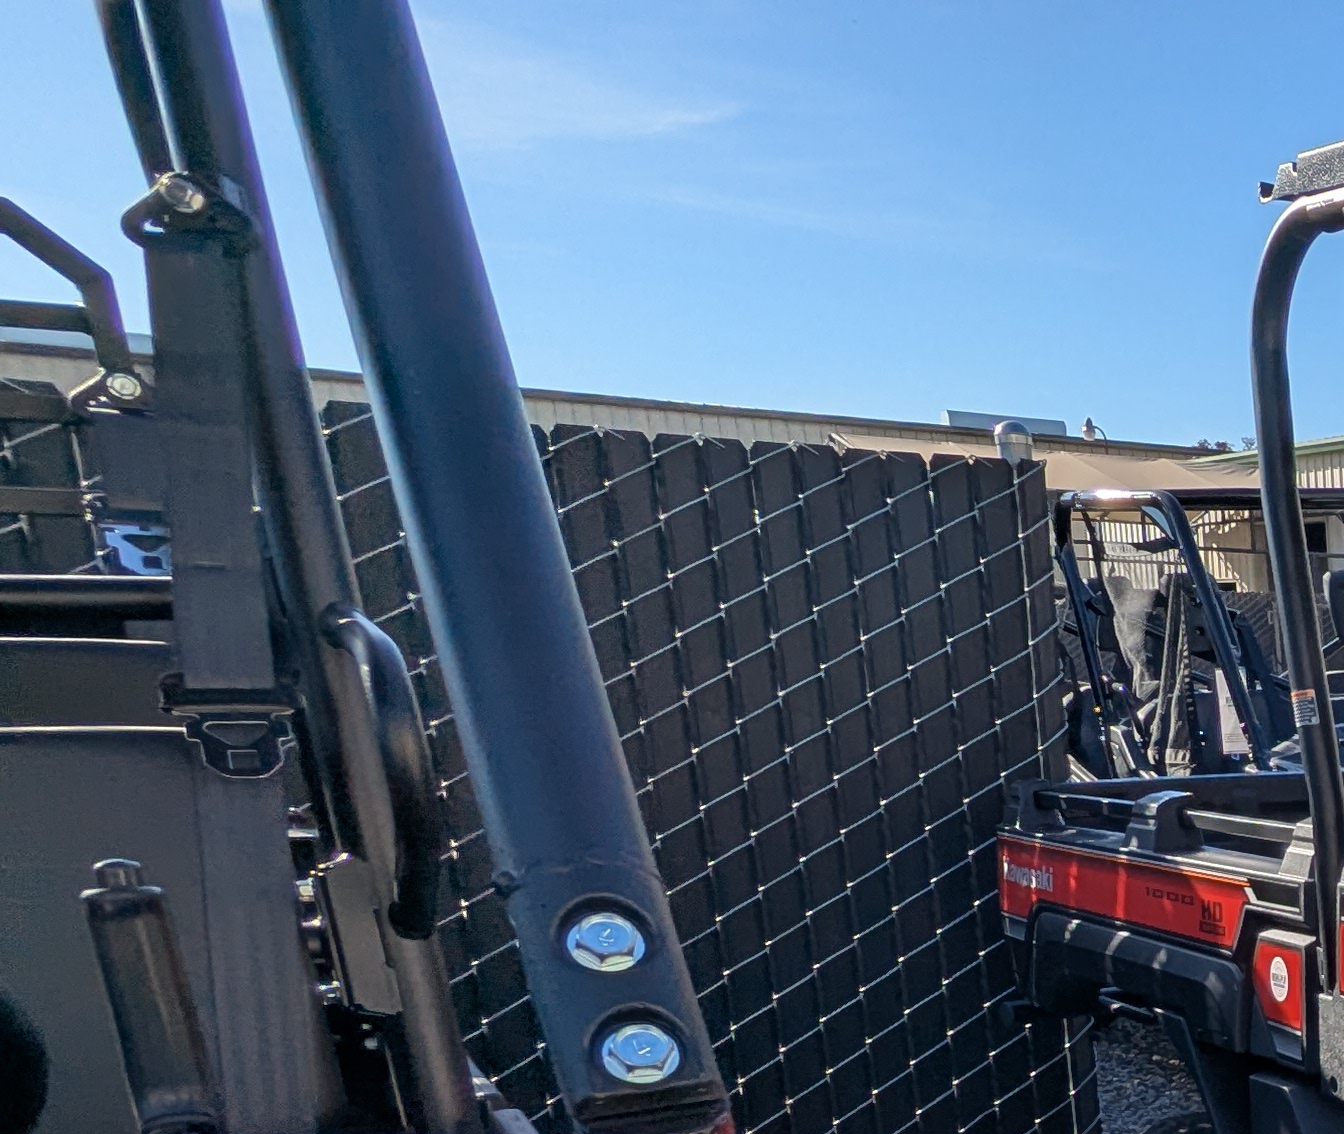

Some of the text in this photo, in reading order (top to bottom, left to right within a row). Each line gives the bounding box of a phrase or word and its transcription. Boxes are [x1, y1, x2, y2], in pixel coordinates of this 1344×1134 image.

[1002, 855, 1053, 892] Kawasaki
[1145, 886, 1194, 906] 1000
[1200, 899, 1223, 923] HD
